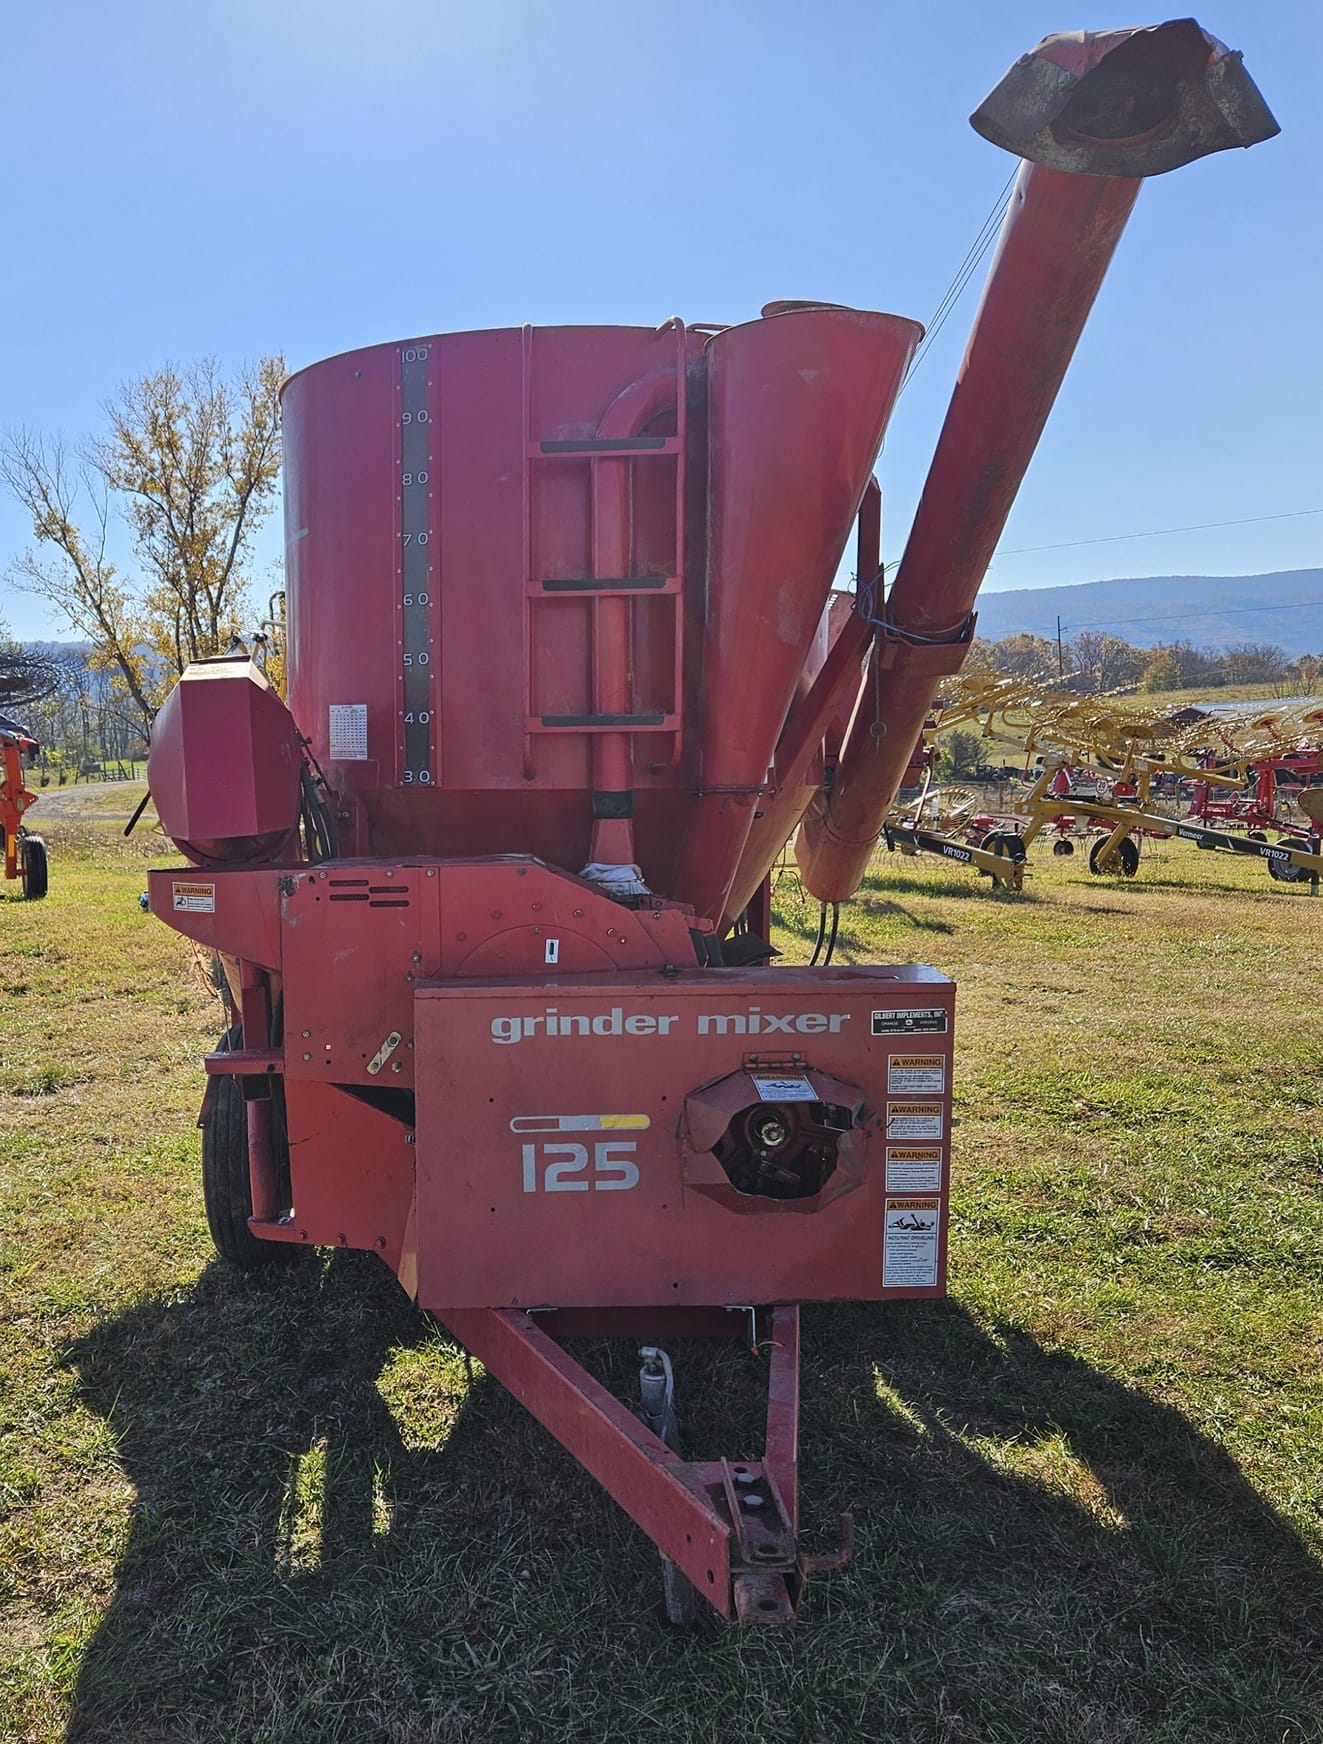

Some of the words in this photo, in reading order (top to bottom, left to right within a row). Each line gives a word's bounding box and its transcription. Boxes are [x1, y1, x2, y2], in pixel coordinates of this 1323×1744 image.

[401, 348, 428, 363] 100
[402, 410, 428, 424] 90
[402, 471, 428, 486] 80
[402, 532, 428, 546] 70
[403, 593, 429, 606] 60
[403, 652, 429, 666] 50
[404, 712, 429, 724] 40
[404, 770, 430, 783] 30
[1178, 828, 1204, 840] Vermeer
[943, 845, 970, 861] VR1022
[1260, 846, 1289, 861] VR1022
[181, 887, 212, 895] WARNING
[490, 1008, 679, 1045] grinder
[697, 1007, 851, 1035] mixer
[901, 1058, 941, 1066] WARNING
[899, 1105, 940, 1113] WARNING
[898, 1151, 938, 1159] WARNING
[522, 1141, 640, 1193] 125
[896, 1201, 937, 1209] WARNING
